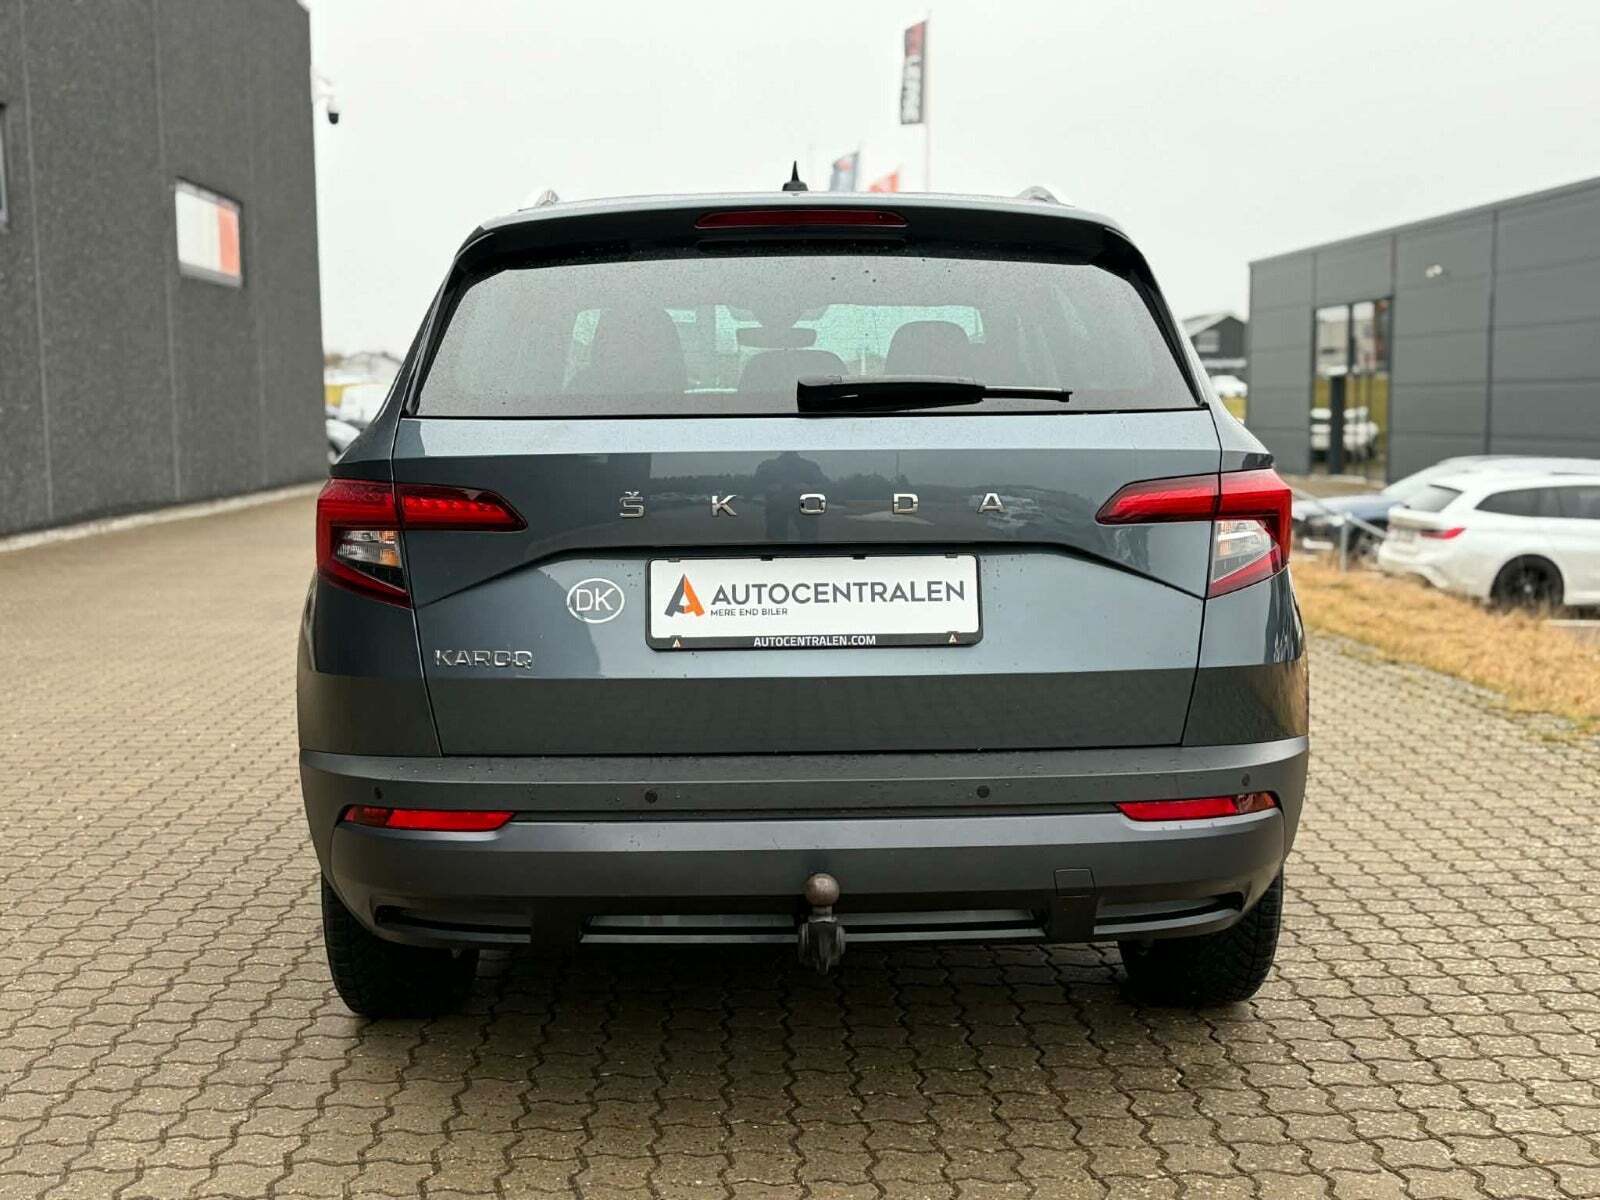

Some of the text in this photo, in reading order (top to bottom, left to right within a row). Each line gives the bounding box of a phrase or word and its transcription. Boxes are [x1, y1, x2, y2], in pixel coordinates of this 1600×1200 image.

[619, 491, 1006, 519] ŠKODA
[575, 587, 615, 612] DK
[711, 580, 965, 606] AUTOCENTRALEN
[710, 608, 788, 617] MERE END BILER
[753, 634, 876, 648] AUTOCENTRALEN.COM
[434, 649, 534, 669] KAROQ
